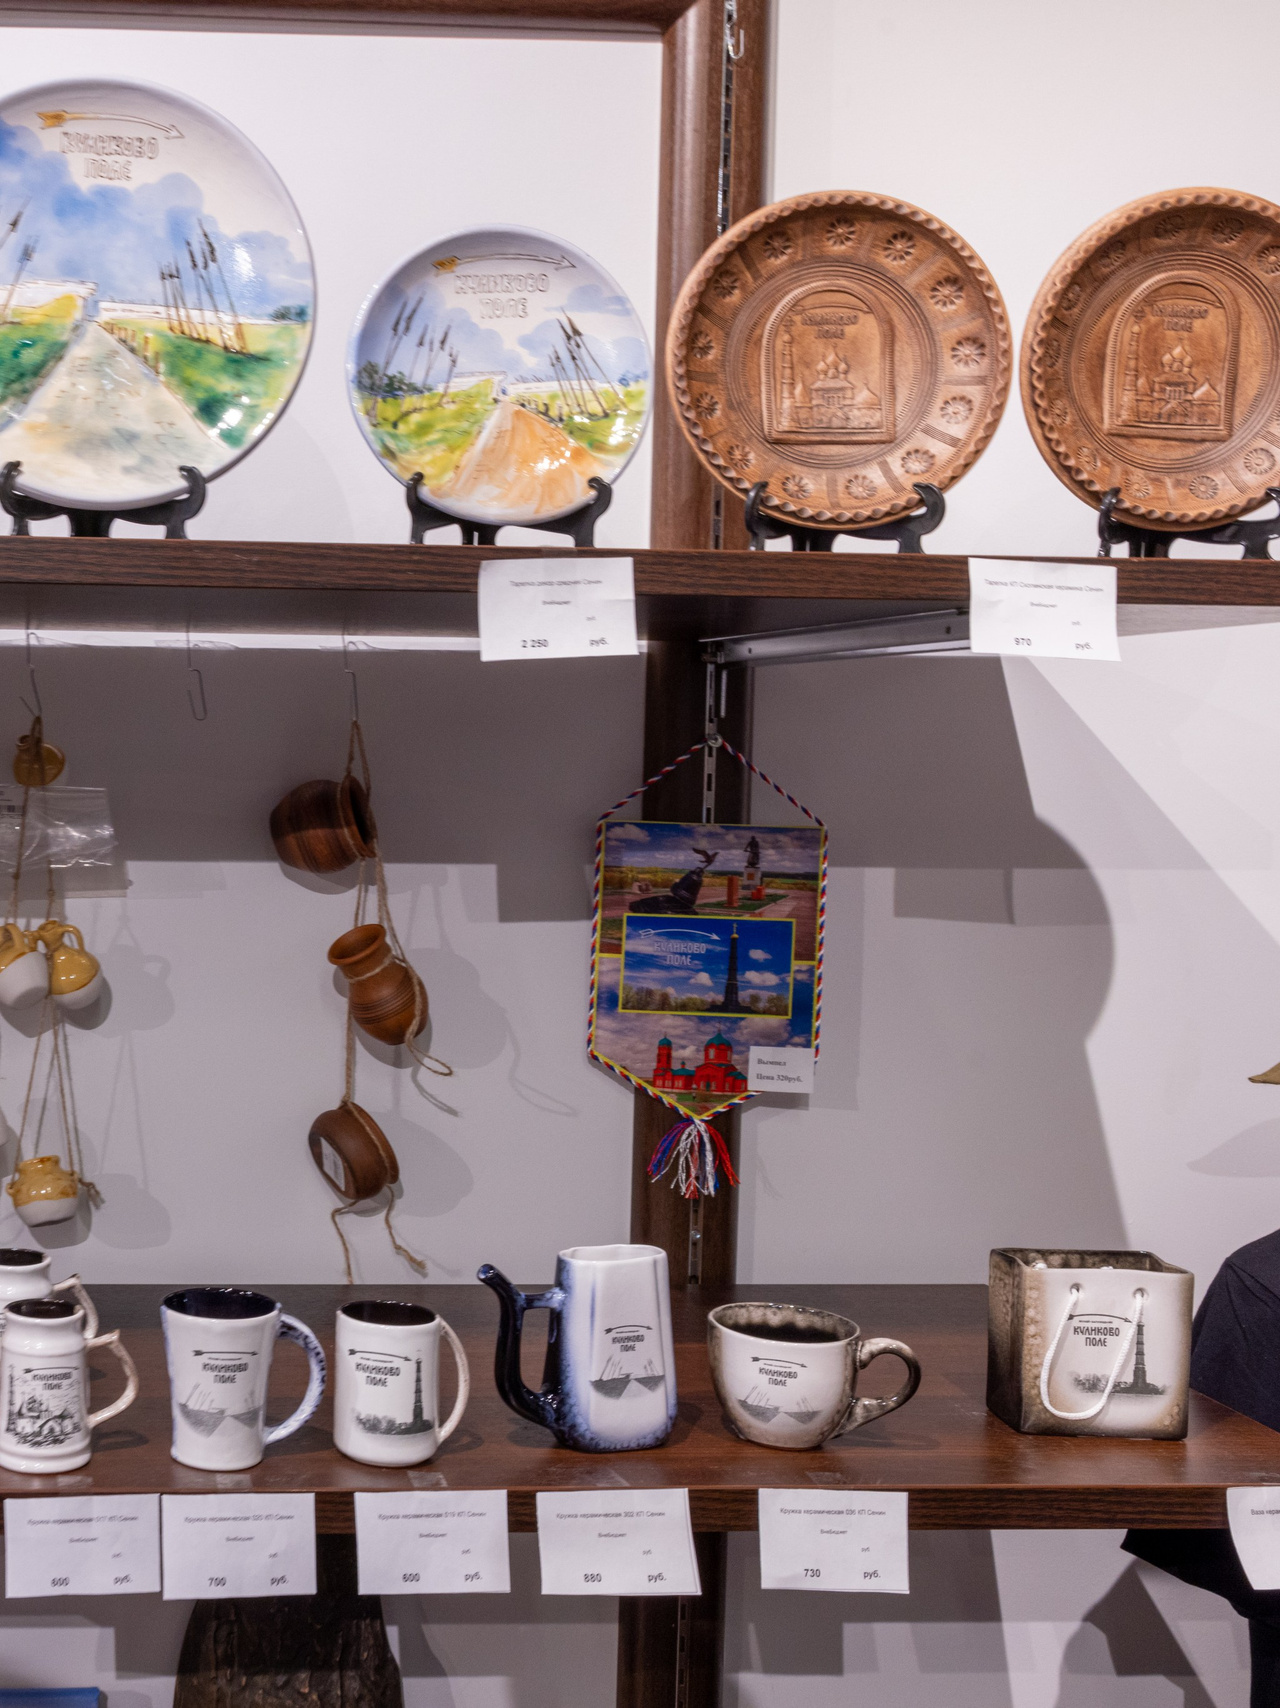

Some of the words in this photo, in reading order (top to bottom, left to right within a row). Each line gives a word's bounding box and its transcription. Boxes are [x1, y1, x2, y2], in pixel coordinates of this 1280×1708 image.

[531, 639, 548, 648] 250
[1014, 637, 1032, 646] 970
[1075, 642, 1093, 651] руб.
[666, 954, 692, 965] ПОЛЕ
[757, 1058, 787, 1066] Вымпел
[756, 1073, 775, 1081] Цена
[1085, 1337, 1107, 1347] ПОЛЕ
[213, 1374, 237, 1384] ПОЛЕ
[365, 1376, 389, 1387] ПОЛЕ
[768, 1377, 787, 1387] ПОЛЕ
[780, 1507, 802, 1515] Кружка
[464, 1571, 483, 1583] руб.
[583, 1573, 602, 1583] 880
[647, 1572, 667, 1583] руб.
[803, 1569, 821, 1578] 730
[863, 1570, 881, 1580] руб.
